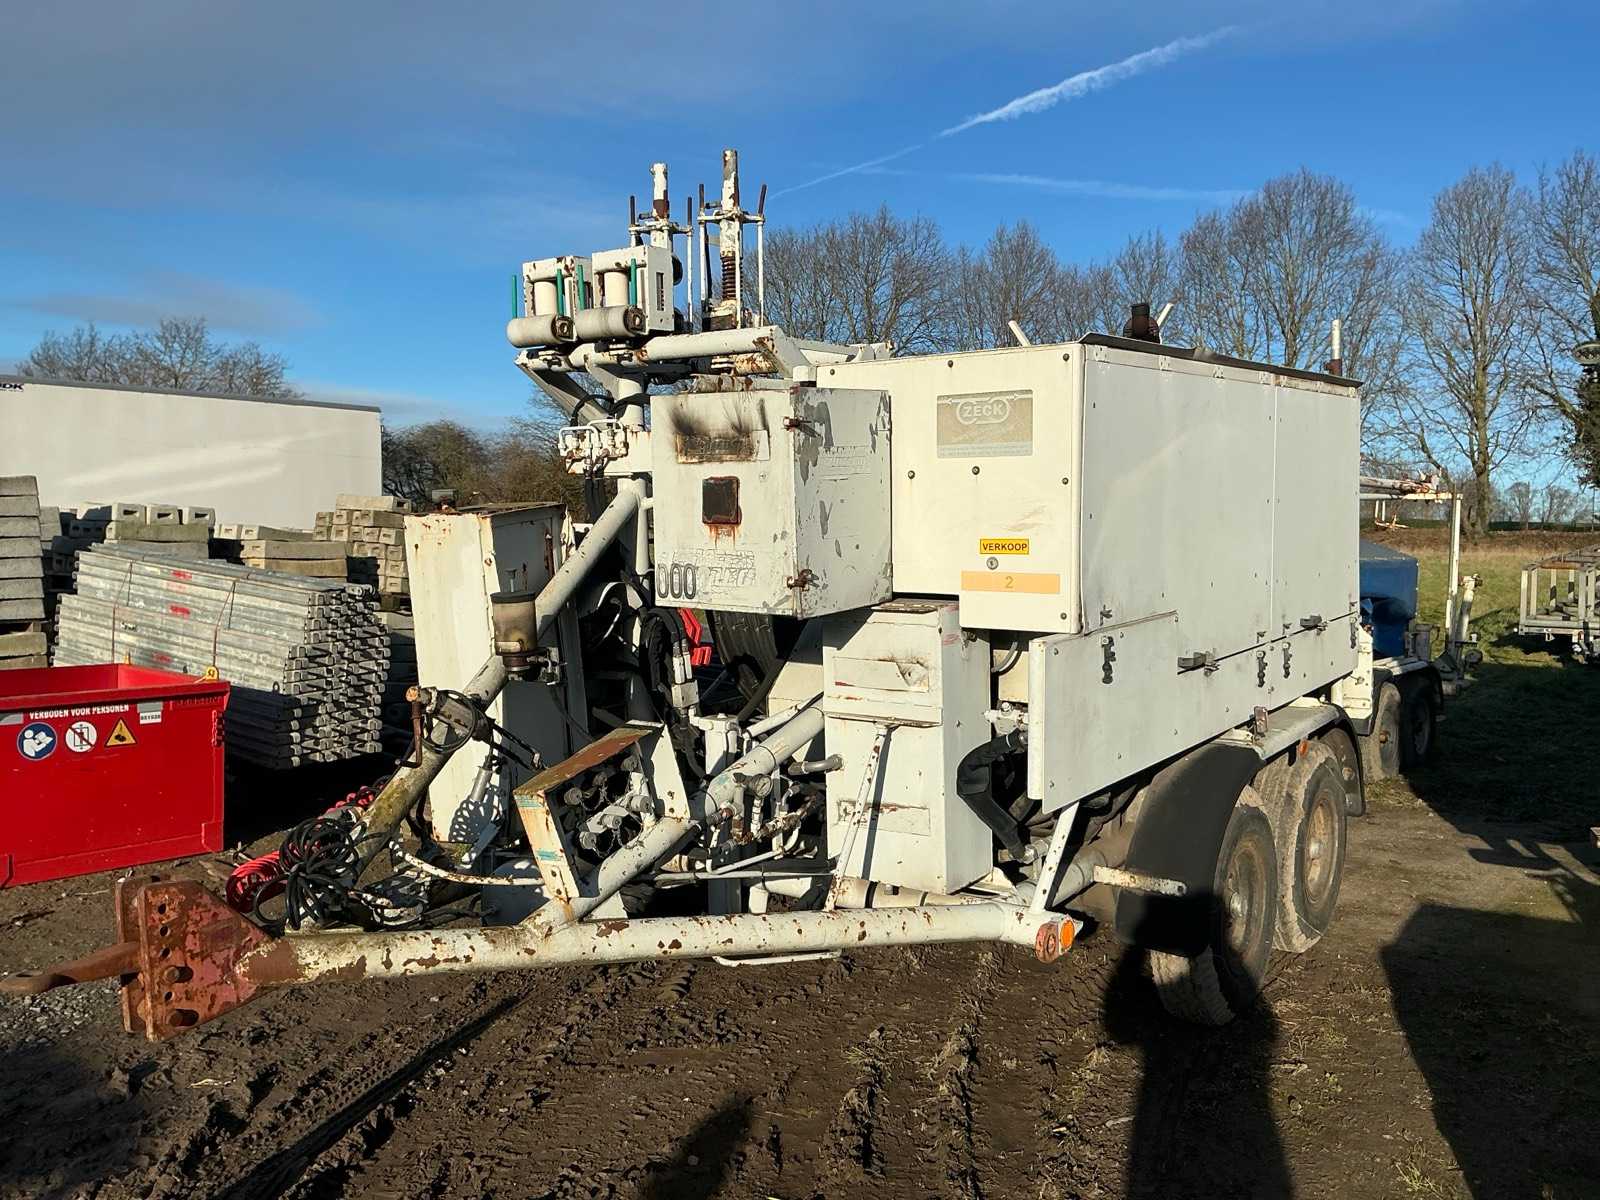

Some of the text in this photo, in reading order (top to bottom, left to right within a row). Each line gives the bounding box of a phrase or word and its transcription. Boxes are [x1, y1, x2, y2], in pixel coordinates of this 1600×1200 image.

[962, 402, 1006, 417] ZECK
[982, 543, 1028, 551] VERKOOP
[1005, 575, 1014, 589] 2
[29, 704, 129, 720] VERBODEN VOOR PERSONEN
